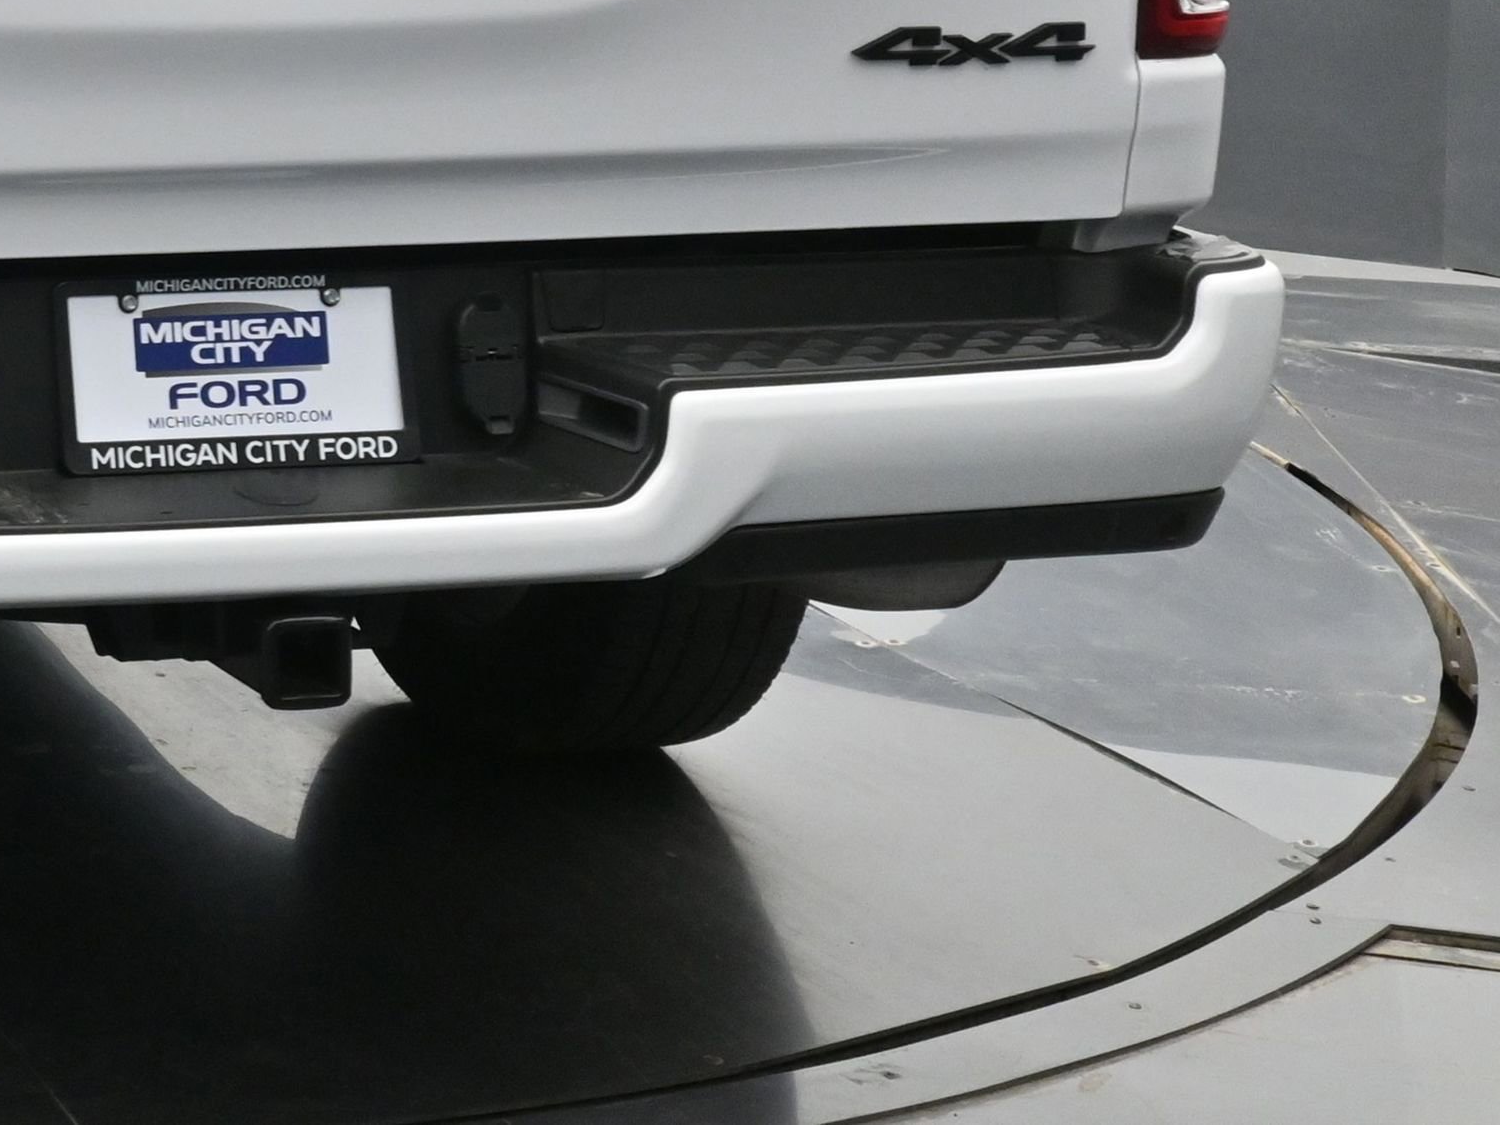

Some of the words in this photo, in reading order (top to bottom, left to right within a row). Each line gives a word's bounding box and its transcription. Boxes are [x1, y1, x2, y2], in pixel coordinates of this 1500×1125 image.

[851, 21, 1096, 66] 4x4
[135, 274, 326, 294] MICHIGANCITYFORD.COM
[139, 315, 322, 345] MICHIGAN
[189, 340, 273, 366] CITY
[168, 377, 307, 410] FORD
[147, 409, 333, 430] MICHIGANCITYFORD.COM
[90, 442, 238, 471] MICHIGAN
[244, 439, 312, 464] CITY
[318, 436, 399, 462] FORD
